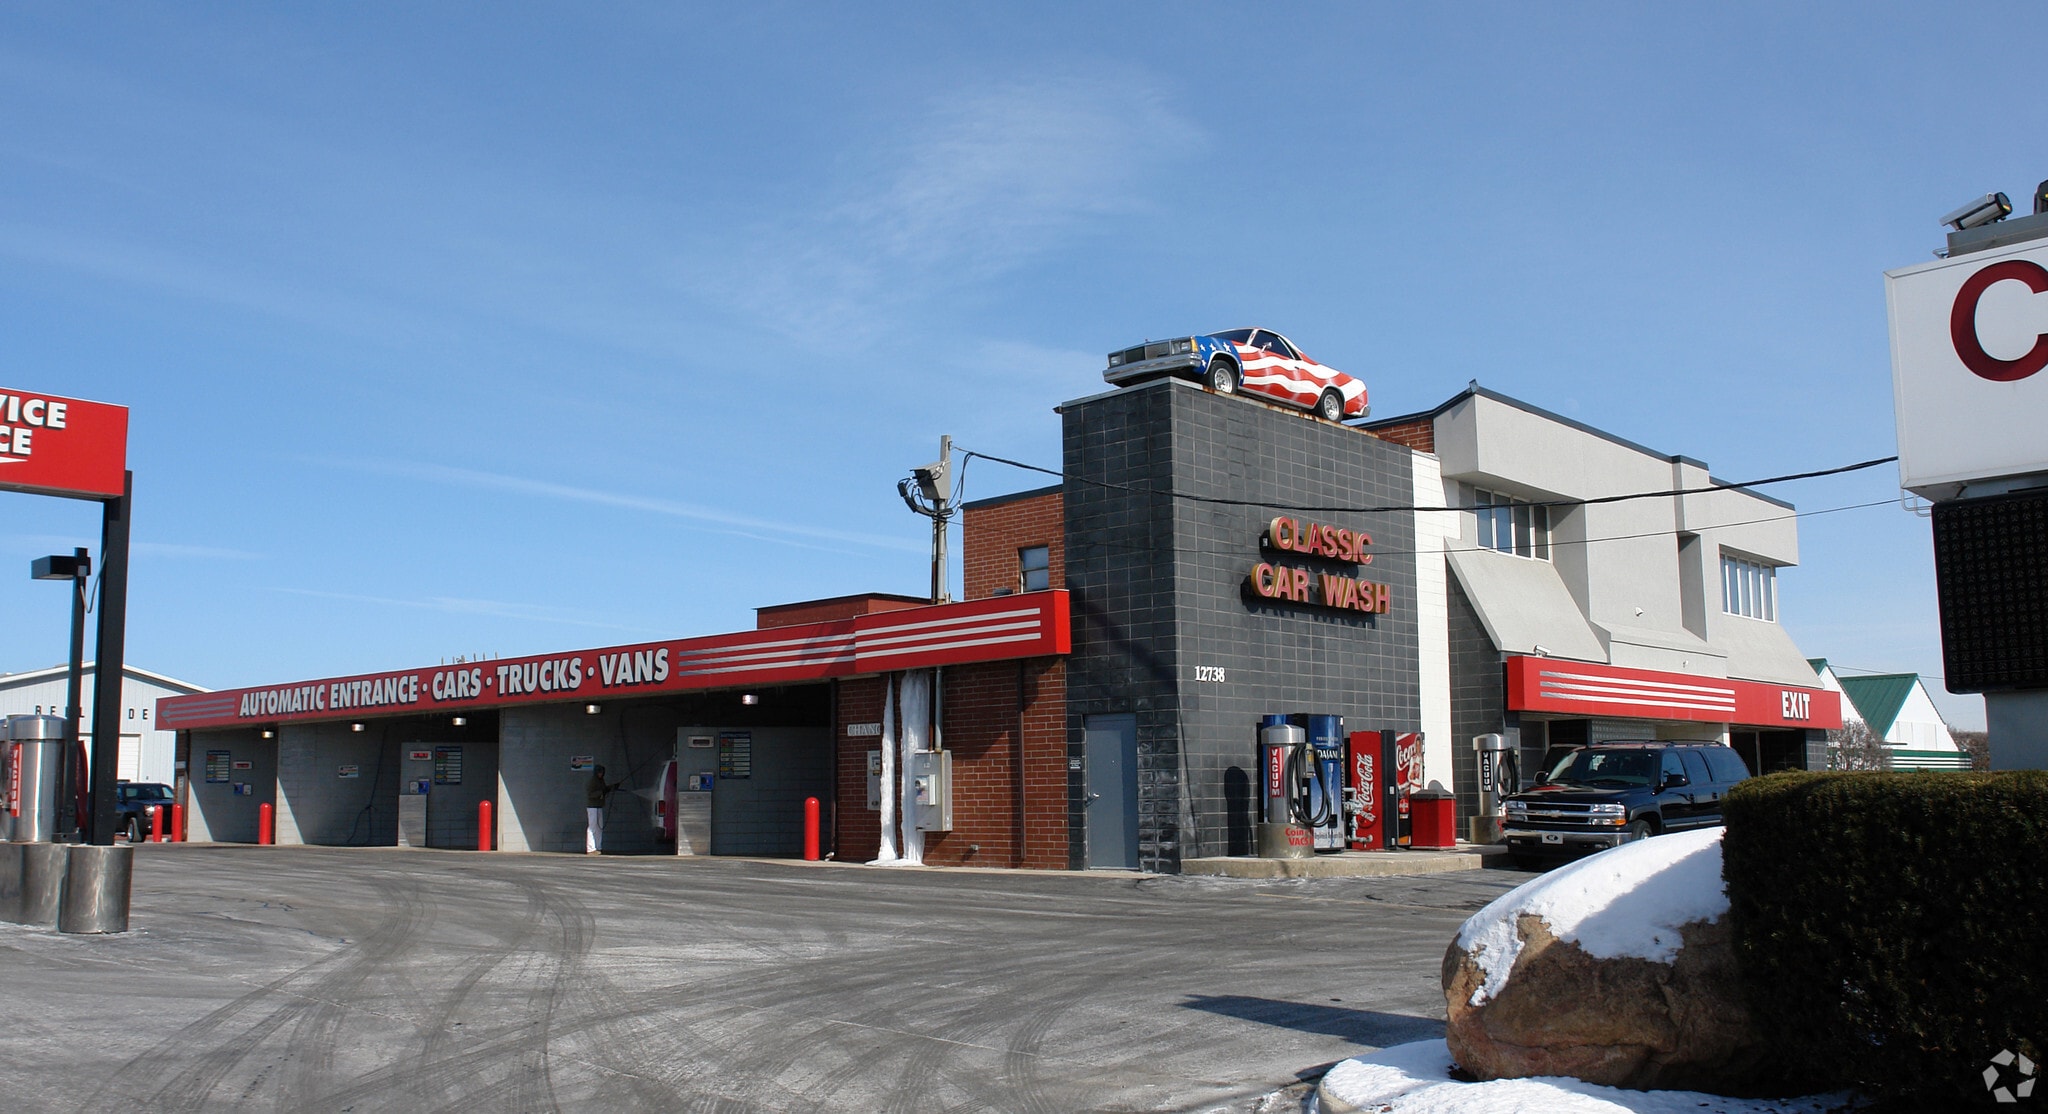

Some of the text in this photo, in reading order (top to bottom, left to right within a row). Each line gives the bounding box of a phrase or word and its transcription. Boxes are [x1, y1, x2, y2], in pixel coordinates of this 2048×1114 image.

[0, 394, 67, 429] ICE
[1270, 516, 1373, 565] CLASSIC
[1251, 562, 1390, 615] CAR WASH
[239, 648, 669, 717] AUTOMATIC ENTRANCE CARS TRUCKS VANS
[1195, 665, 1225, 683] 12738
[1781, 690, 1810, 720] EXIT
[1271, 748, 1280, 796] VACUUM
[1483, 751, 1492, 792] VACUUM
